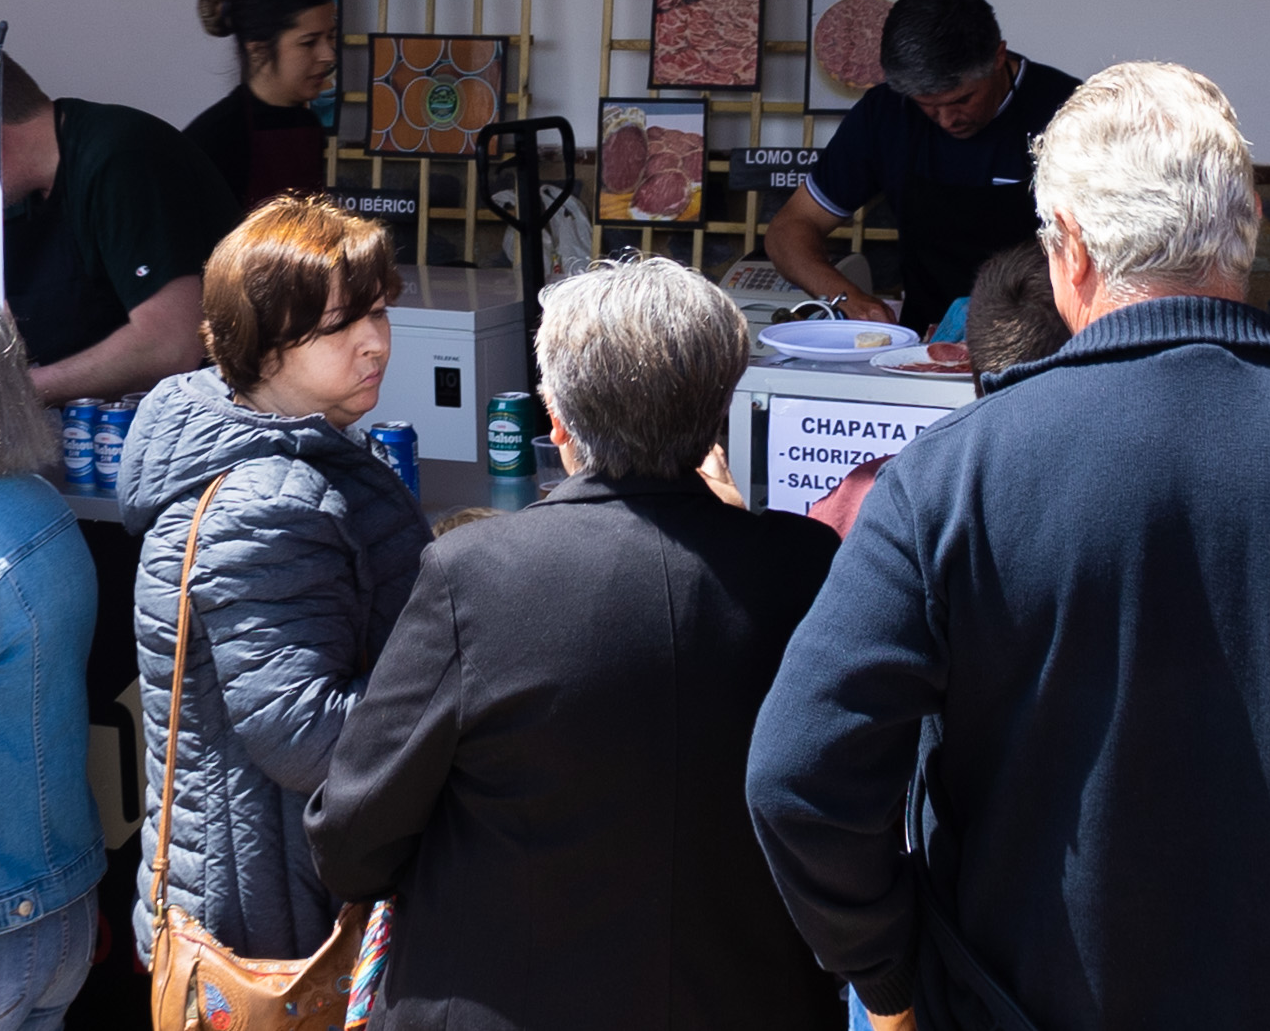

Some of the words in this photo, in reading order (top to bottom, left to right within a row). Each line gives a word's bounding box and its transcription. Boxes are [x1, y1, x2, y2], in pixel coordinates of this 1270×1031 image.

[745, 150, 793, 165] LOMO
[359, 196, 416, 214] IBÉRICO
[801, 417, 907, 441] CHAPATA
